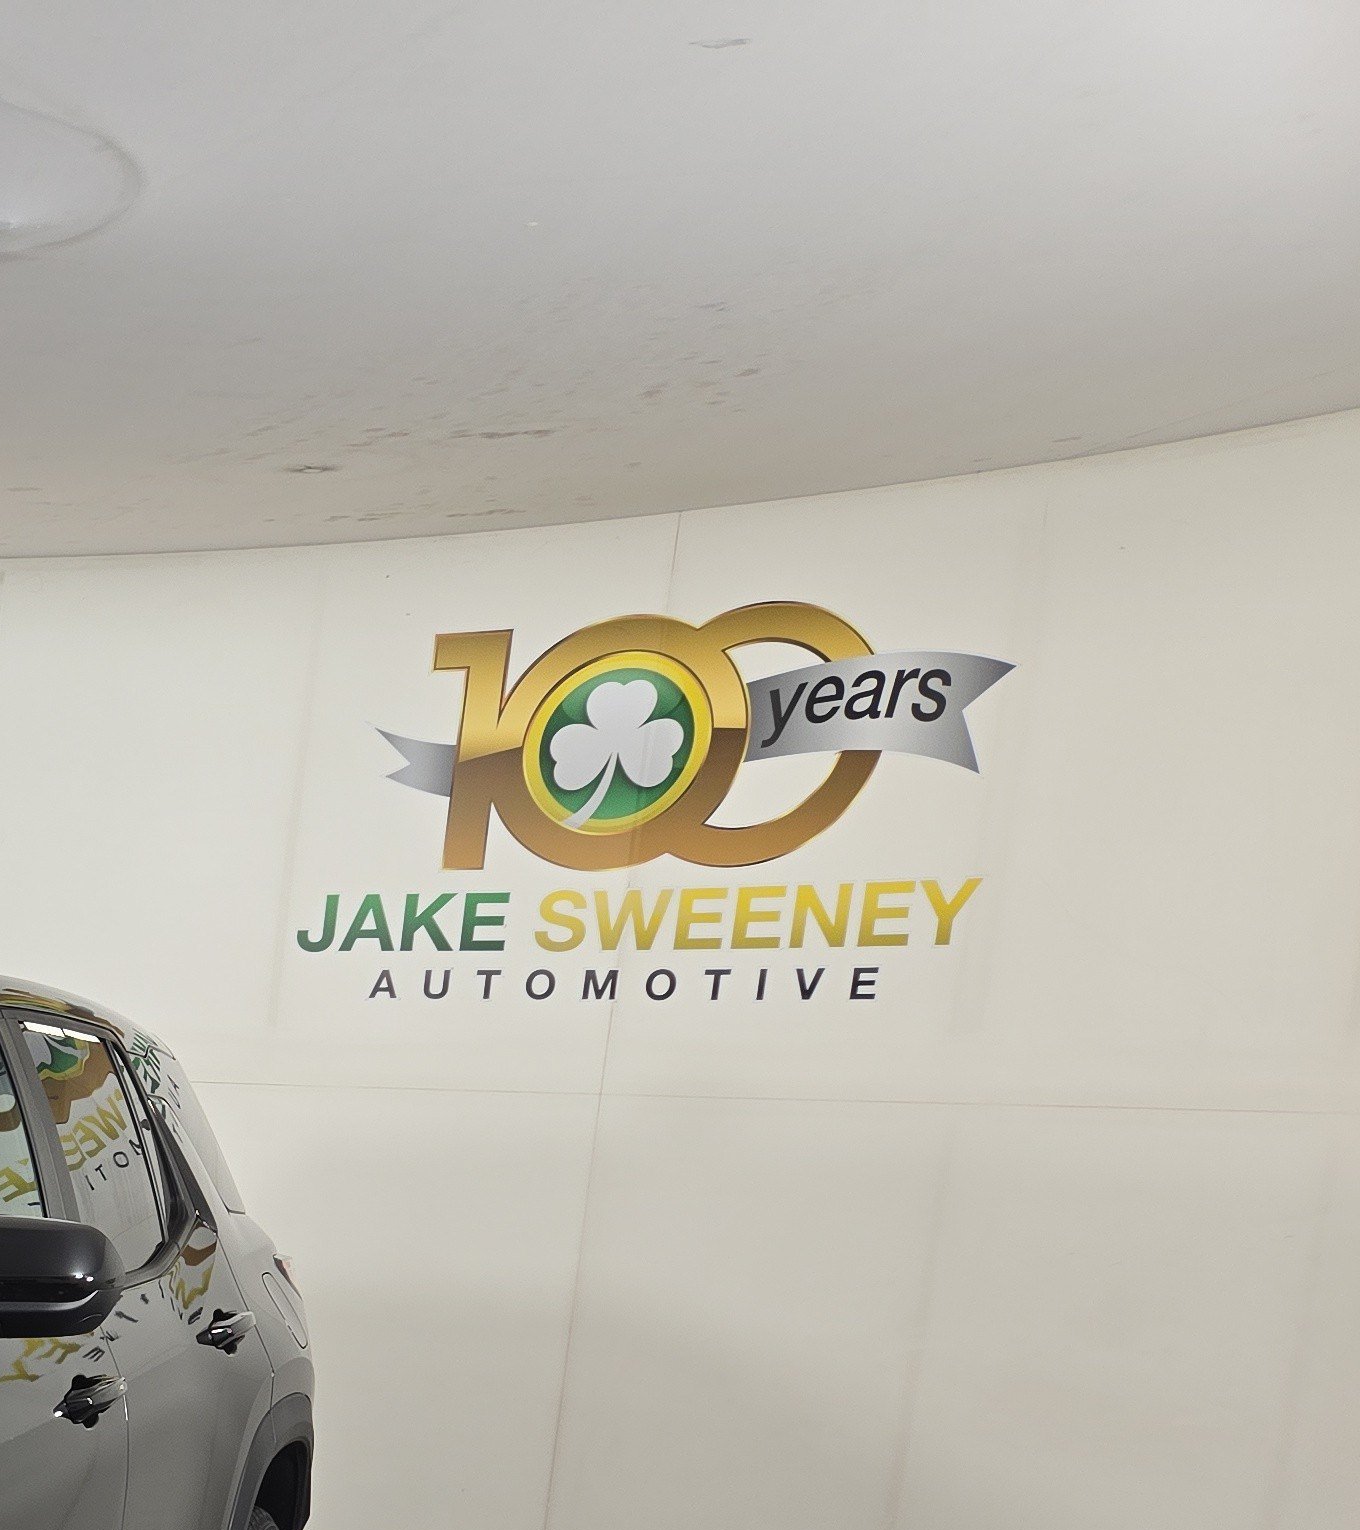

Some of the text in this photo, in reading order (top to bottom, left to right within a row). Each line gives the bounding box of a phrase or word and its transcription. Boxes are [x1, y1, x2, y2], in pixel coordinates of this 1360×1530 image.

[432, 600, 953, 872] 100 years
[296, 877, 983, 953] JAKE SWEENEY
[368, 966, 880, 1001] AUTOMOTIVE
